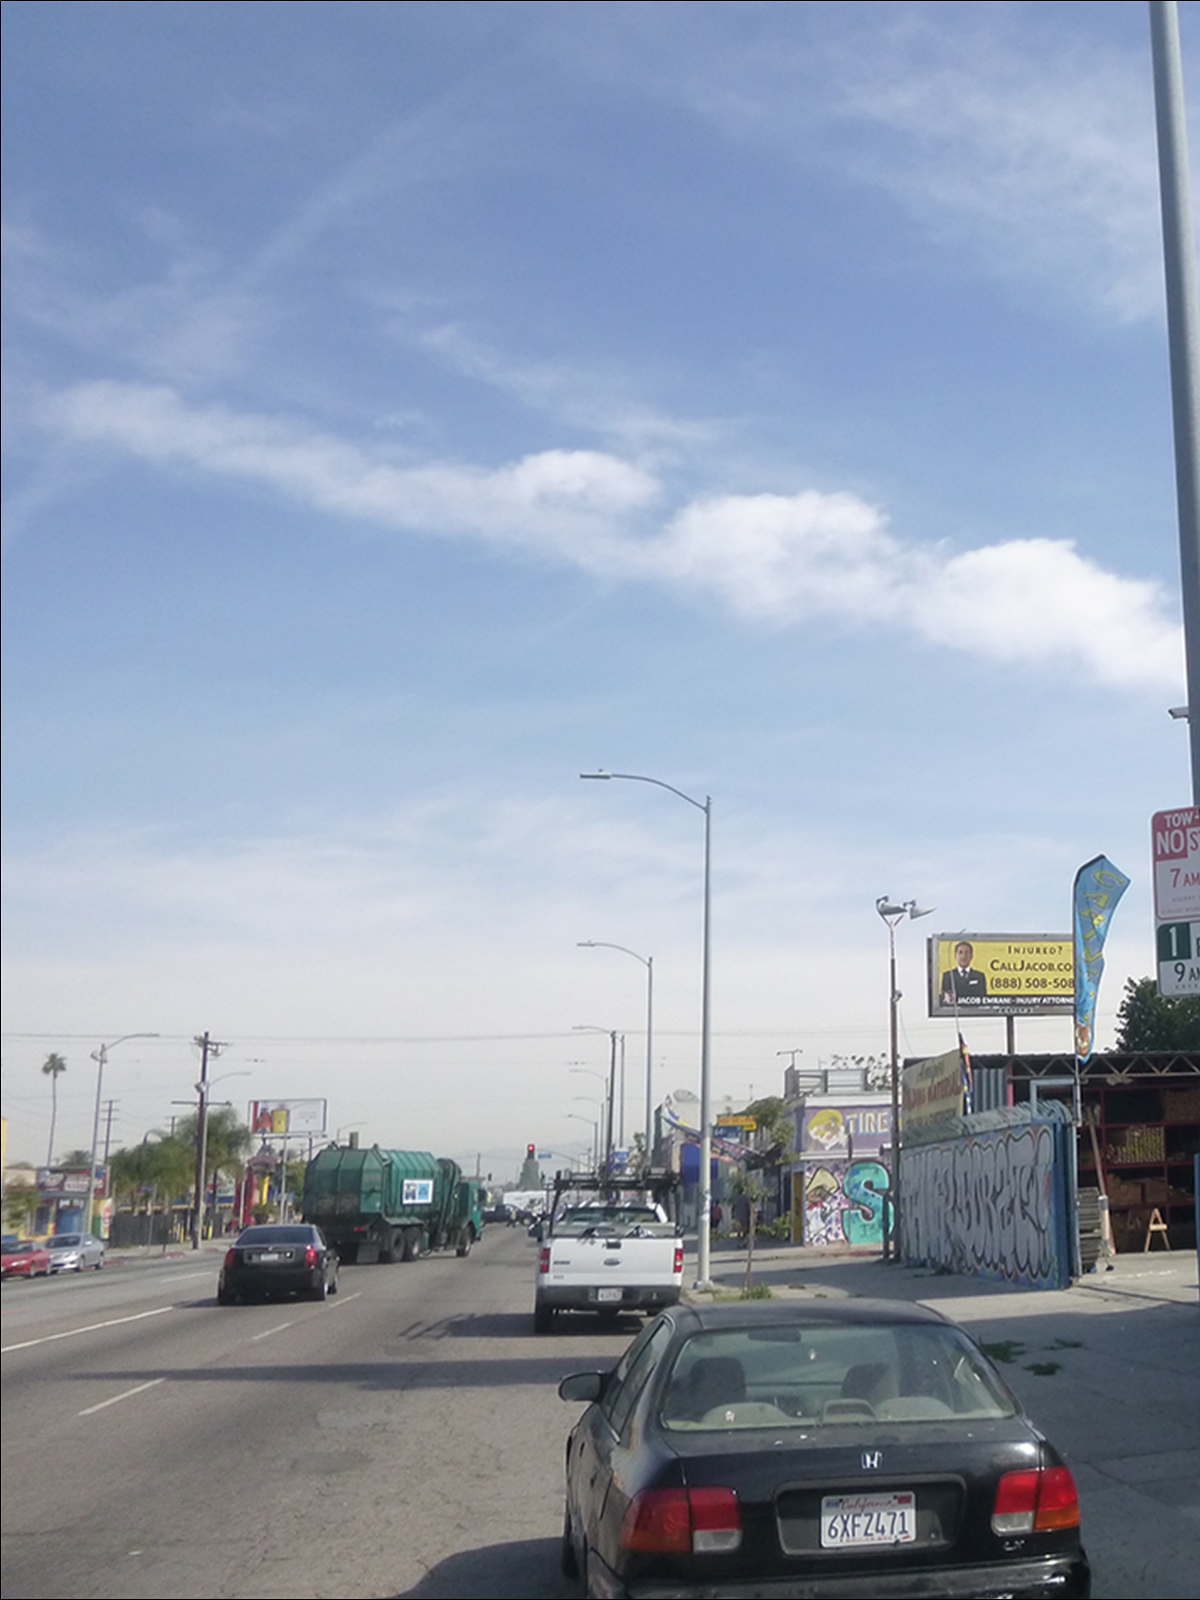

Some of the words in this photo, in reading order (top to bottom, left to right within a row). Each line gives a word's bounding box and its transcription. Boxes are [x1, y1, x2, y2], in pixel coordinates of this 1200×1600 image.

[1156, 828, 1185, 856] NO
[1169, 926, 1177, 957] 1
[990, 977, 1022, 989] (888)
[1025, 977, 1075, 989] 508-508
[957, 996, 980, 1004] JACOB
[1042, 996, 1075, 1004] ATTORNE
[841, 1497, 892, 1512] California
[828, 1511, 908, 1539] 6XFZ471
